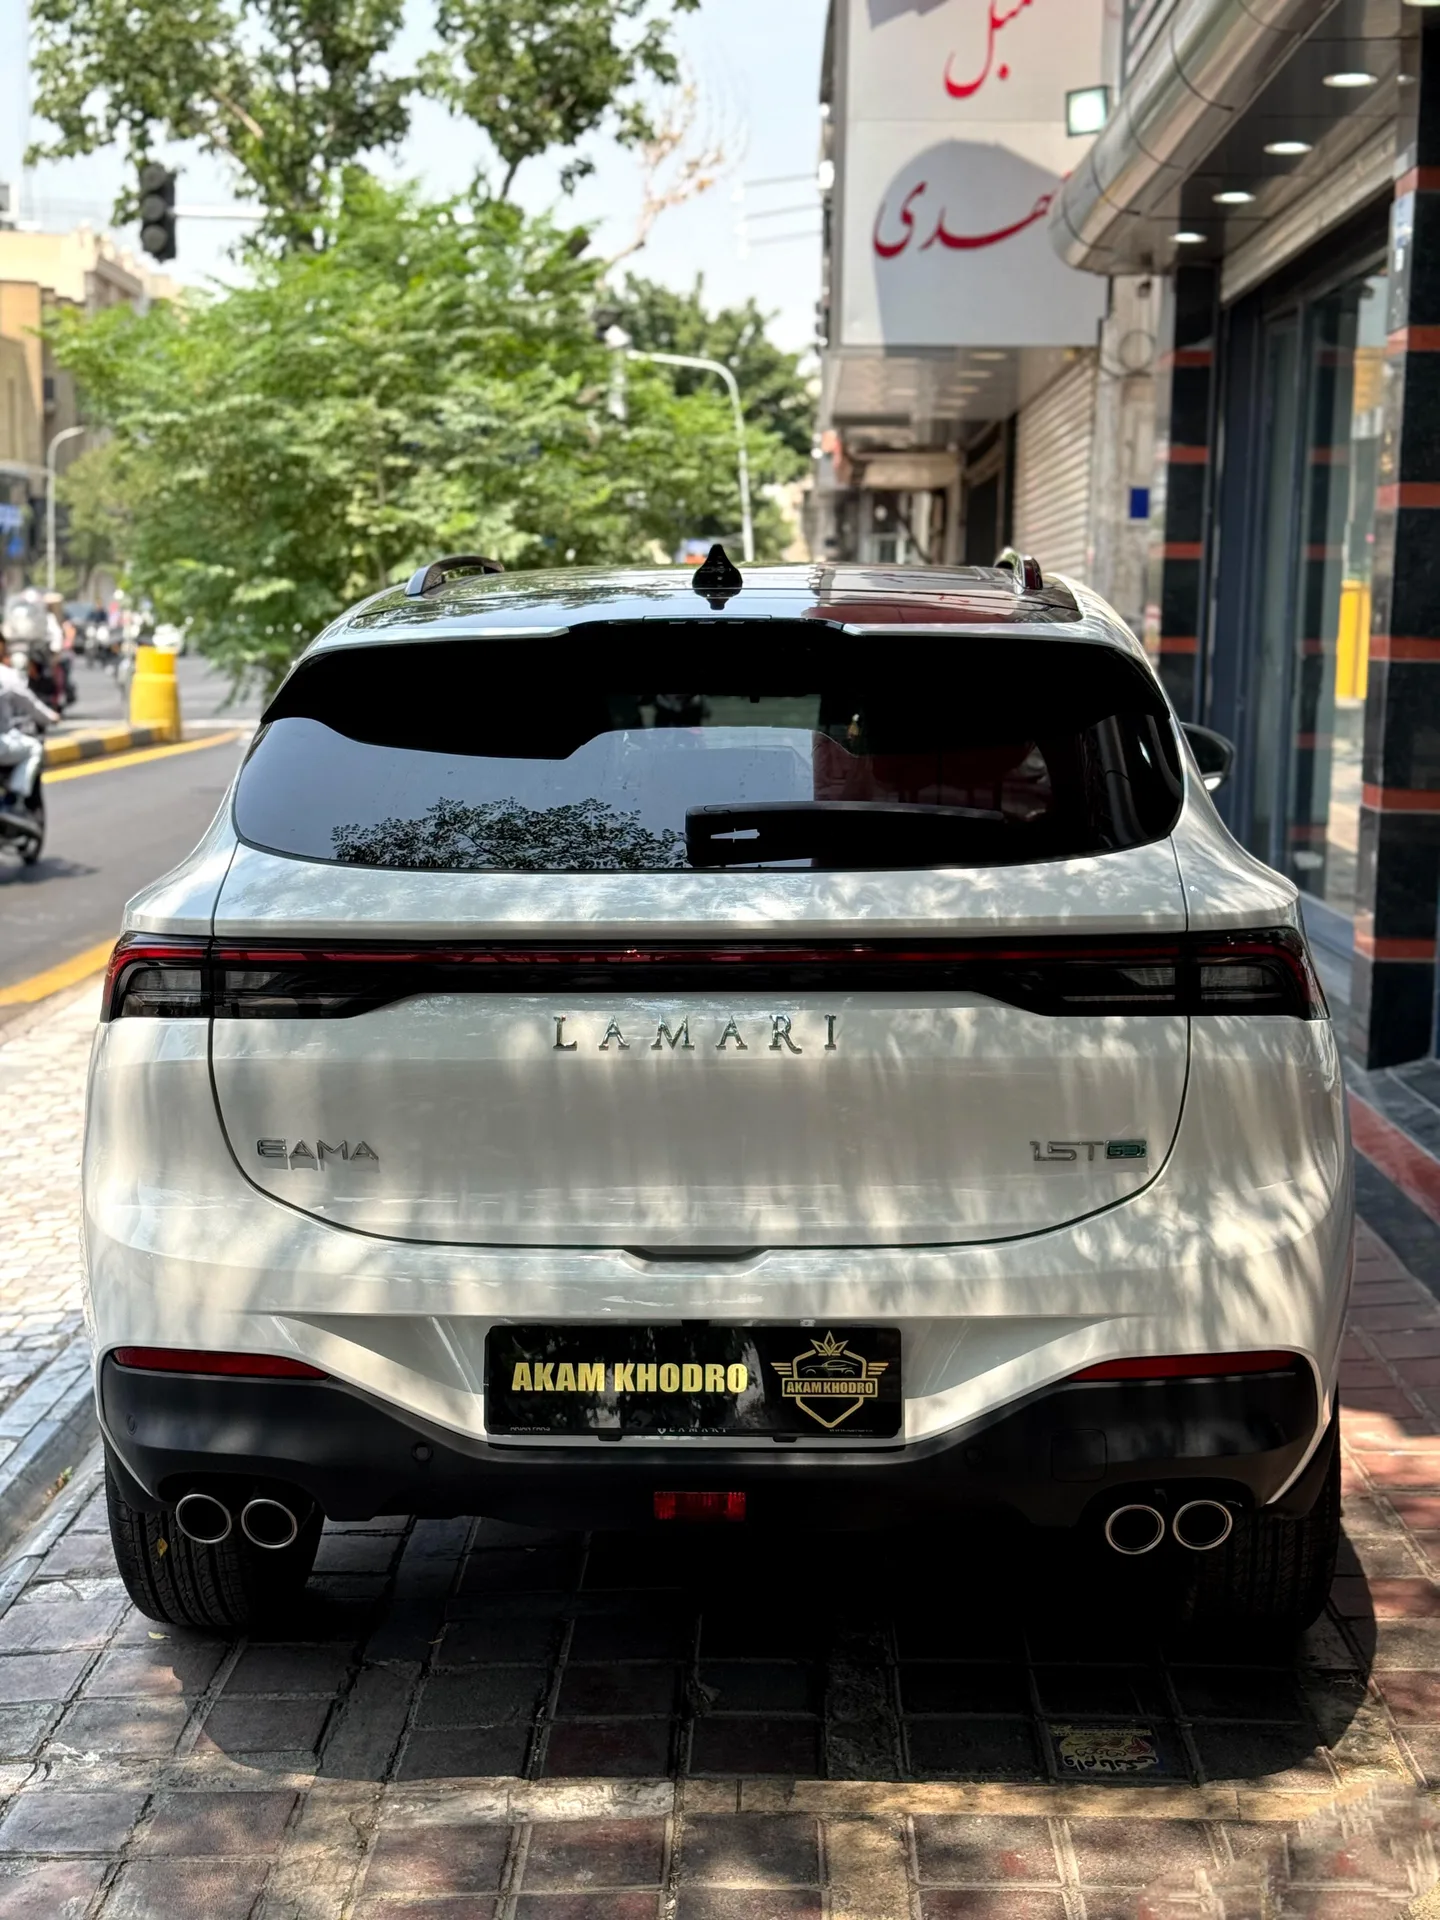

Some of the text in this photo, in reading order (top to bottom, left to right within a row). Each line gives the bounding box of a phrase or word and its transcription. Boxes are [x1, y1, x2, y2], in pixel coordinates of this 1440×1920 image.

[553, 1013, 840, 1054] LAMARI
[256, 1138, 380, 1161] EAMA
[511, 1362, 749, 1394] AKAM KHODRO
[786, 1381, 874, 1394] AKAM KHODRO
